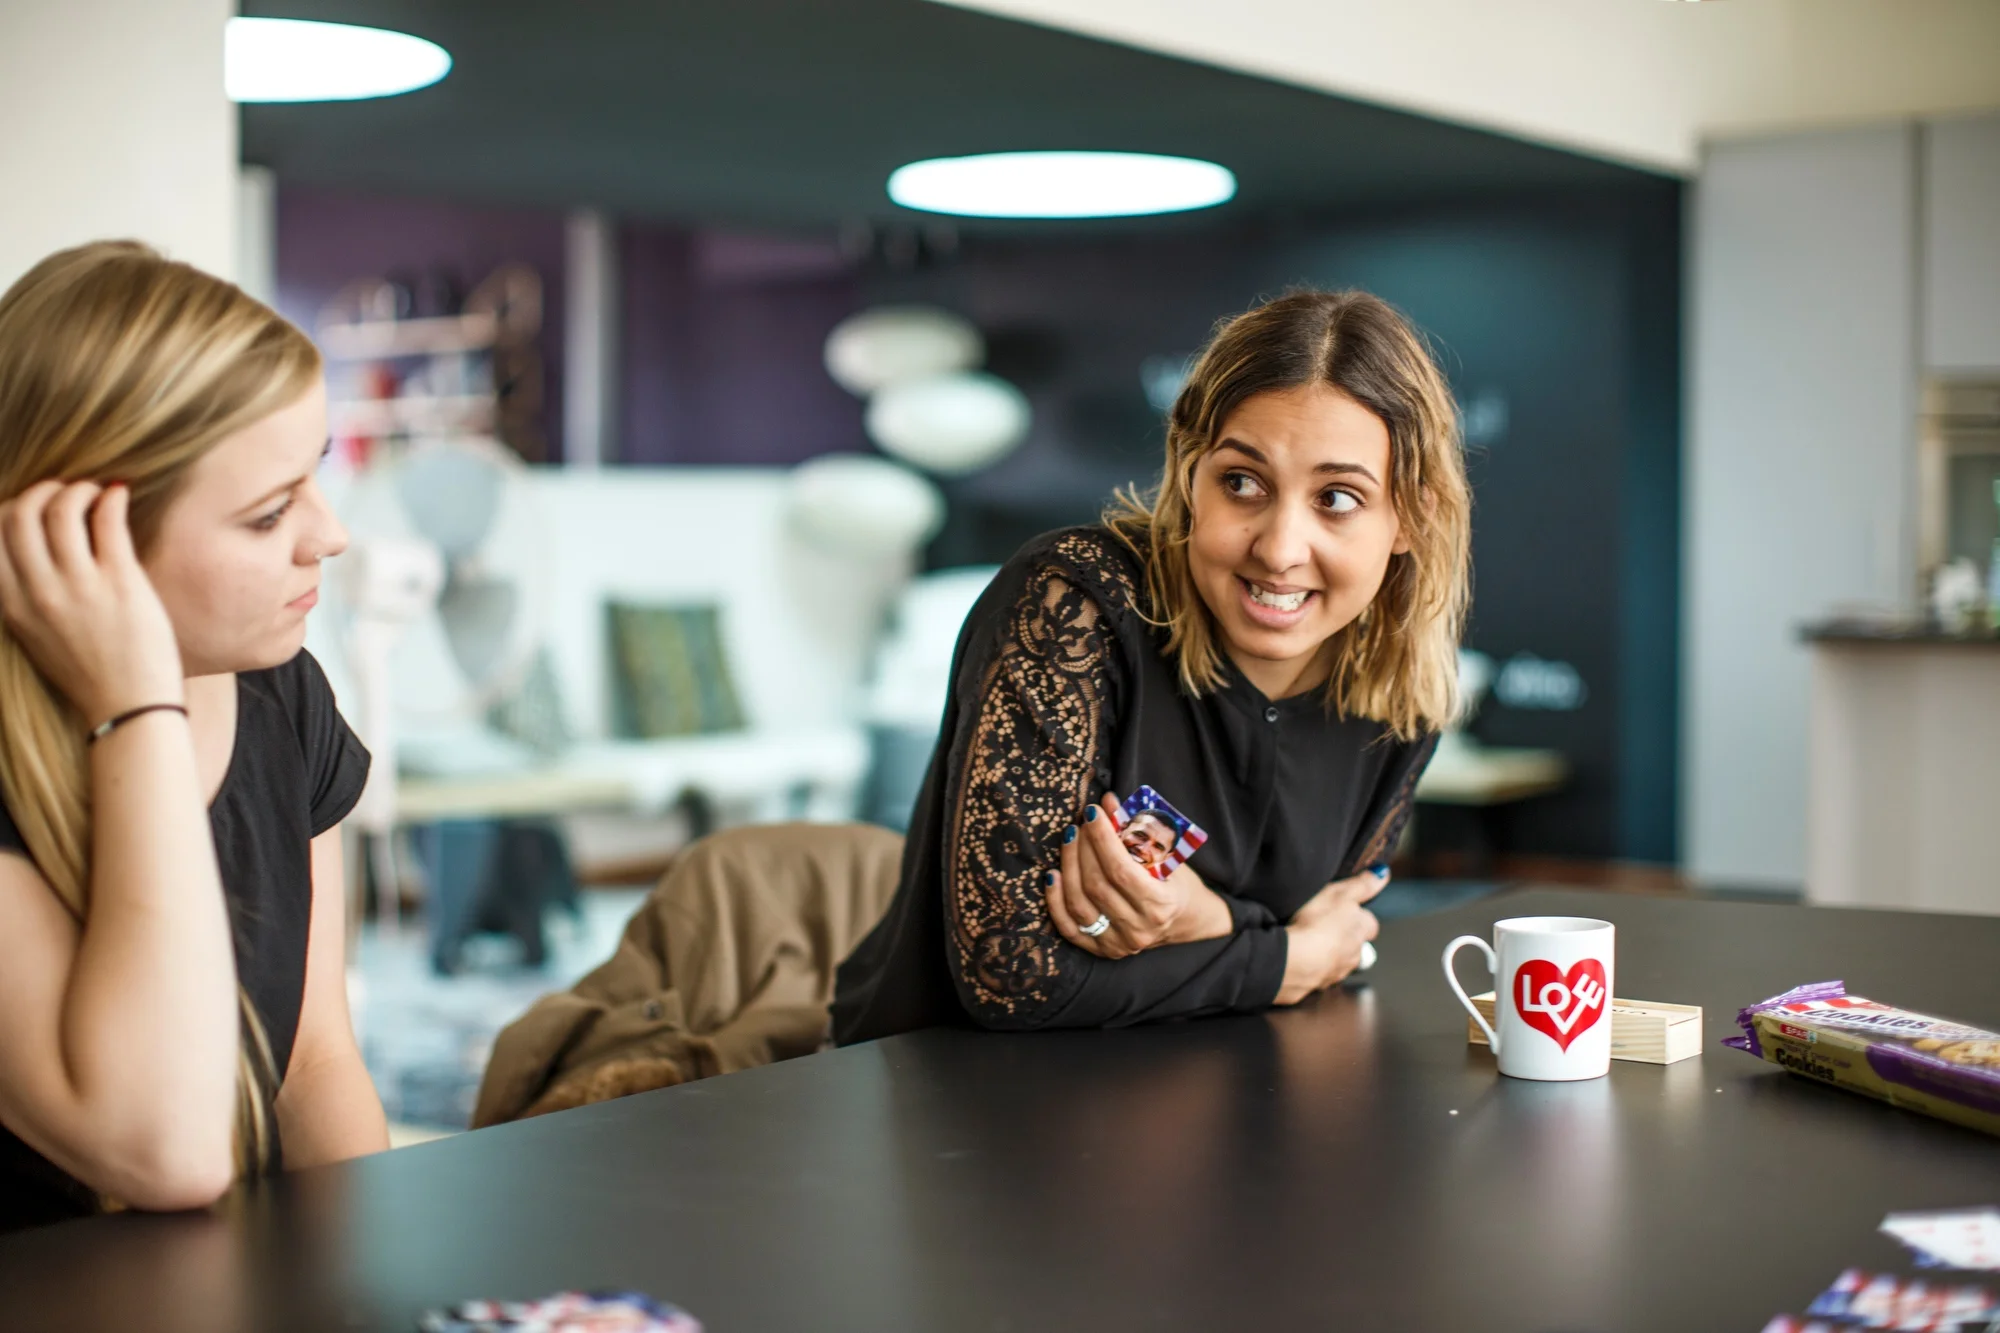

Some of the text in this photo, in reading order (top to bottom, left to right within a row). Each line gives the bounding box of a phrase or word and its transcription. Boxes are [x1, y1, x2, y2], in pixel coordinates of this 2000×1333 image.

[1523, 973, 1604, 1035] LOVE
[1785, 1026, 1809, 1040] SPAR
[1804, 1009, 1934, 1030] Cookies
[1775, 1047, 1835, 1082] Cookies
